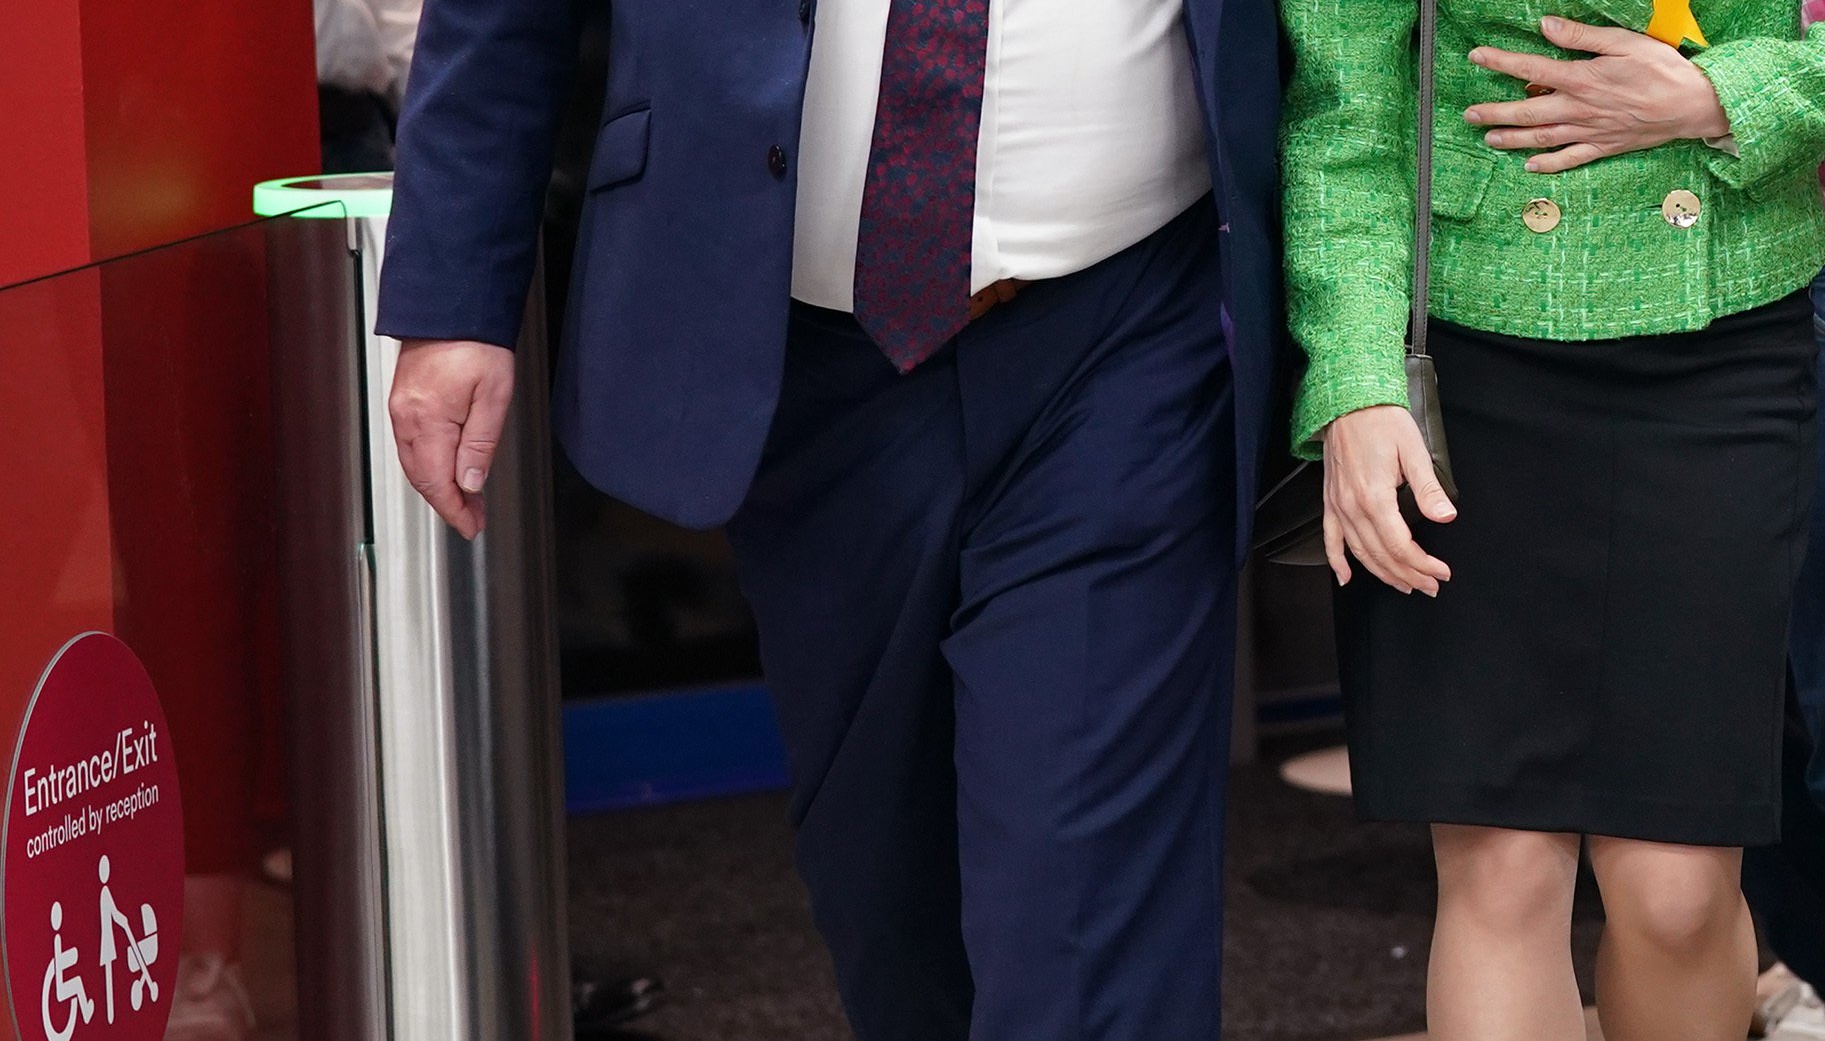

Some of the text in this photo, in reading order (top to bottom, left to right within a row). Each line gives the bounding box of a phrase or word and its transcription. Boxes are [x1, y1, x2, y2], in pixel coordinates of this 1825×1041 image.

[23, 720, 158, 817] Entrance/Exit
[26, 782, 159, 859] controlled by reception
